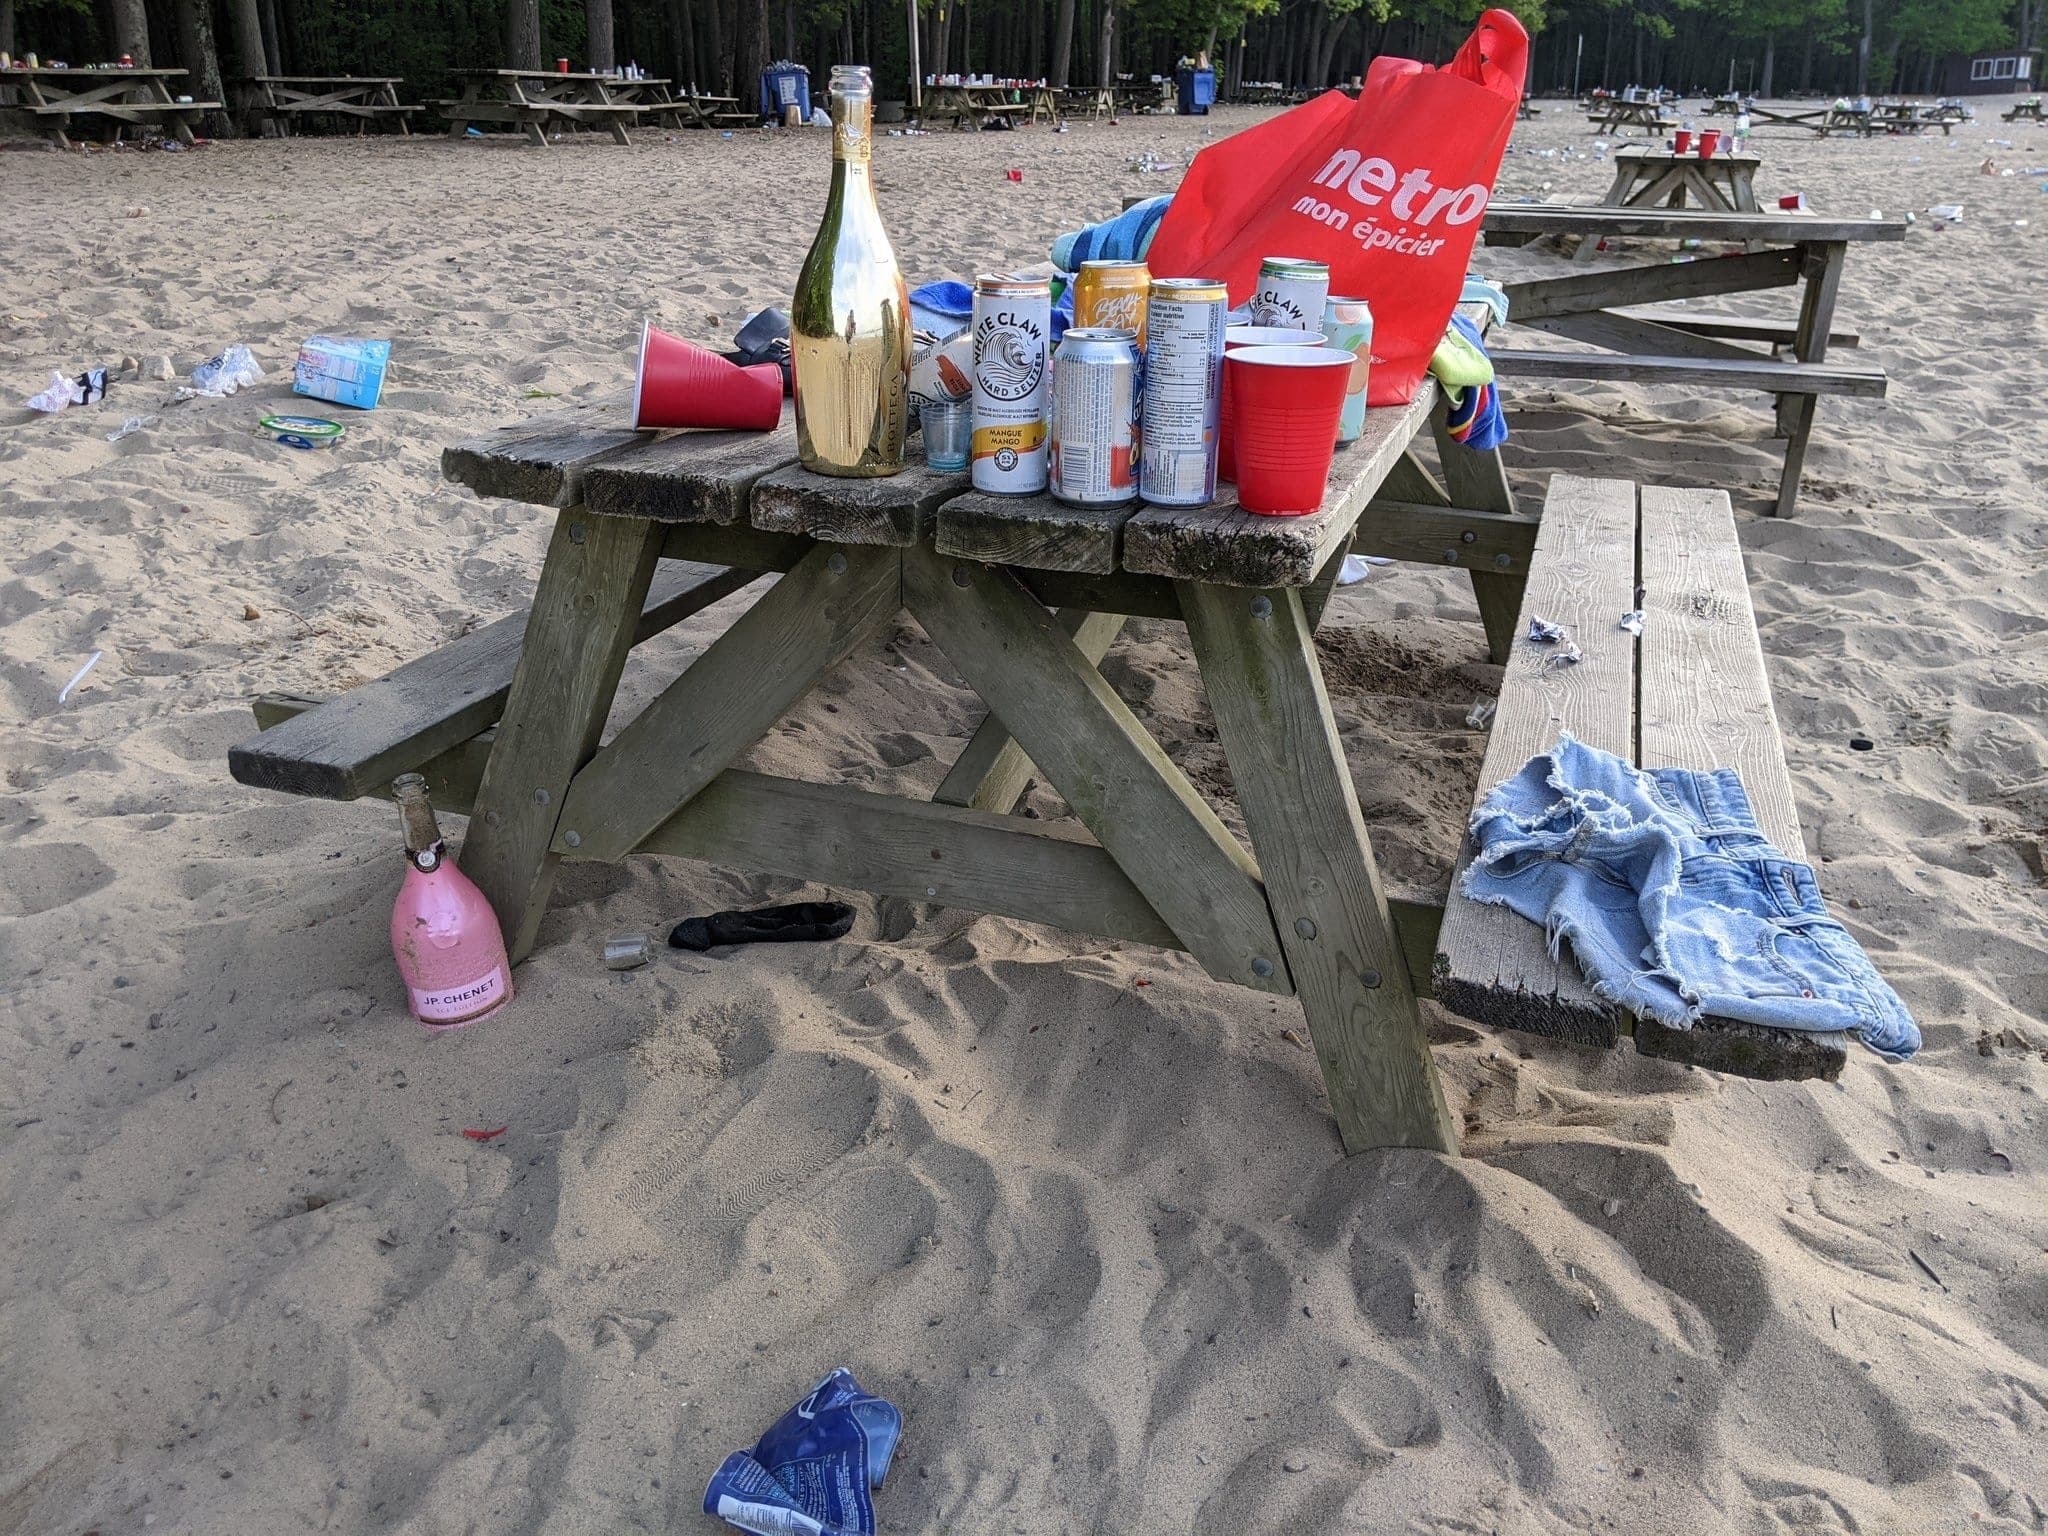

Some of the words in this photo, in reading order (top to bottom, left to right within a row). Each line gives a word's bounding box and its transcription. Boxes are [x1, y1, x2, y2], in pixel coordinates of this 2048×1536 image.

[1291, 195, 1350, 231] mon
[1352, 216, 1446, 257] épicier
[1264, 290, 1304, 320] CLAW
[974, 316, 995, 366] WHITE
[997, 312, 1042, 341] CLAW
[982, 376, 1009, 397] HARD
[1014, 352, 1043, 396] SELTZER
[886, 375, 899, 453] BOTTEGA
[989, 429, 1023, 437] MANGUE
[990, 438, 1021, 446] MANGO
[424, 996, 441, 1005] JP.
[443, 978, 495, 1005] CHENET
